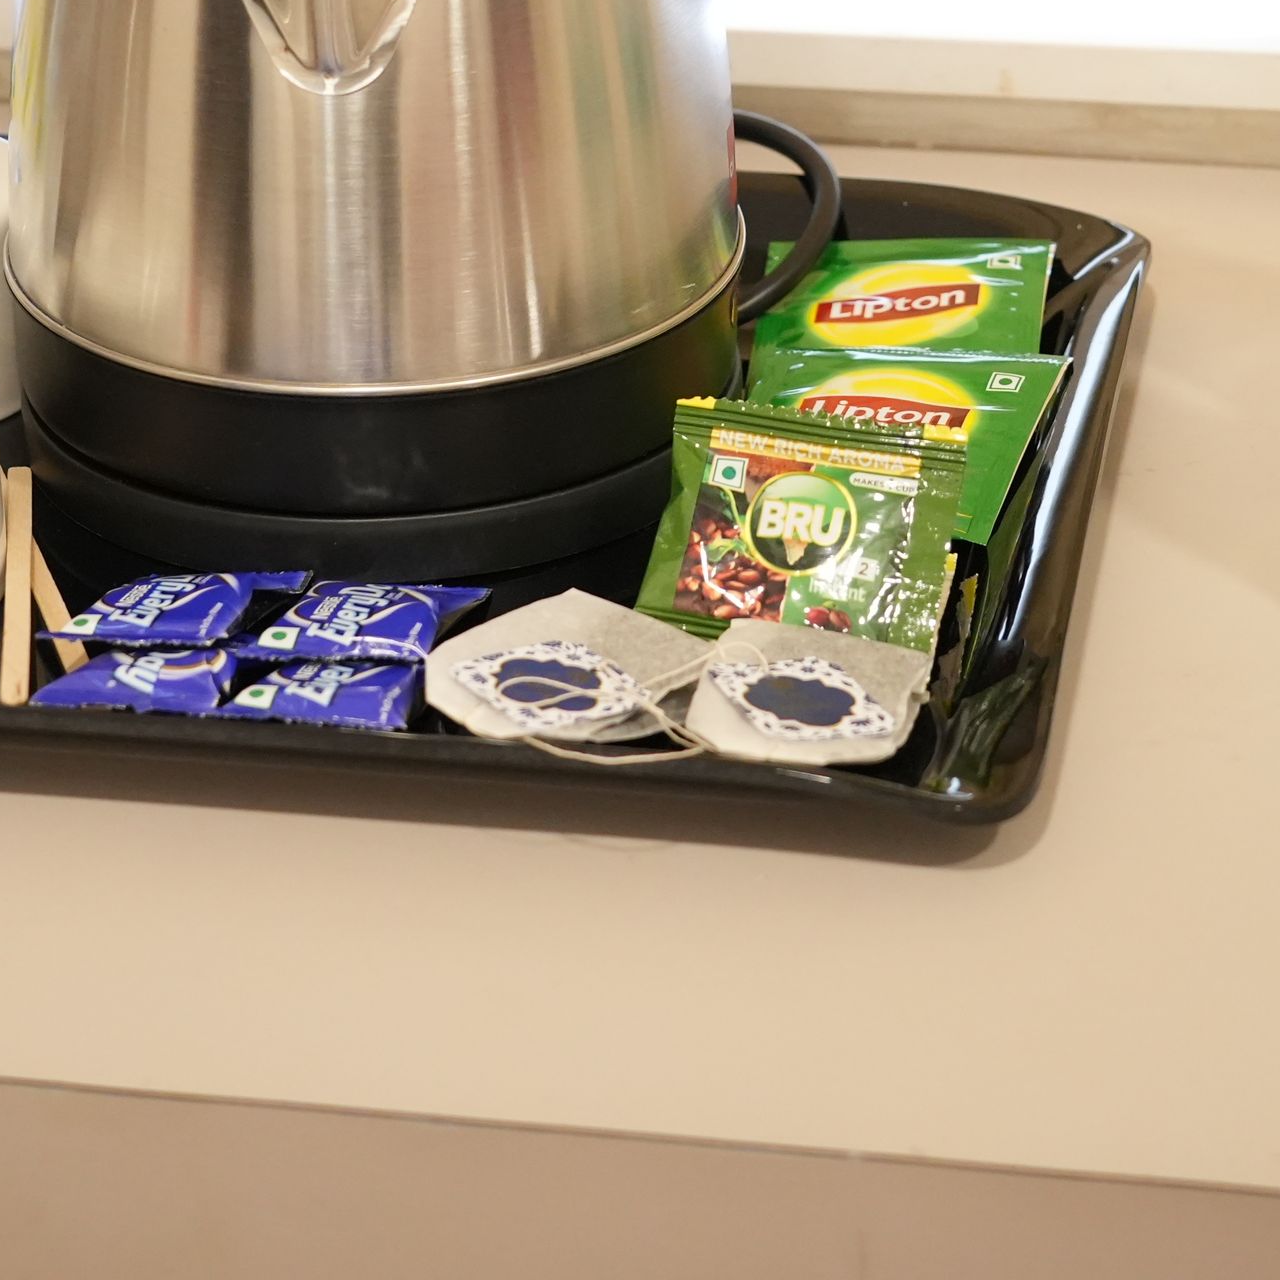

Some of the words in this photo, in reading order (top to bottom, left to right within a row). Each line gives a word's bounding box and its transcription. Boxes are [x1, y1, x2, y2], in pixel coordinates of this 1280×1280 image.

[829, 289, 966, 319] Lipton
[719, 428, 769, 451] NEW
[773, 437, 822, 460] RICH
[828, 446, 906, 472] AROMA
[756, 499, 846, 546] BRU
